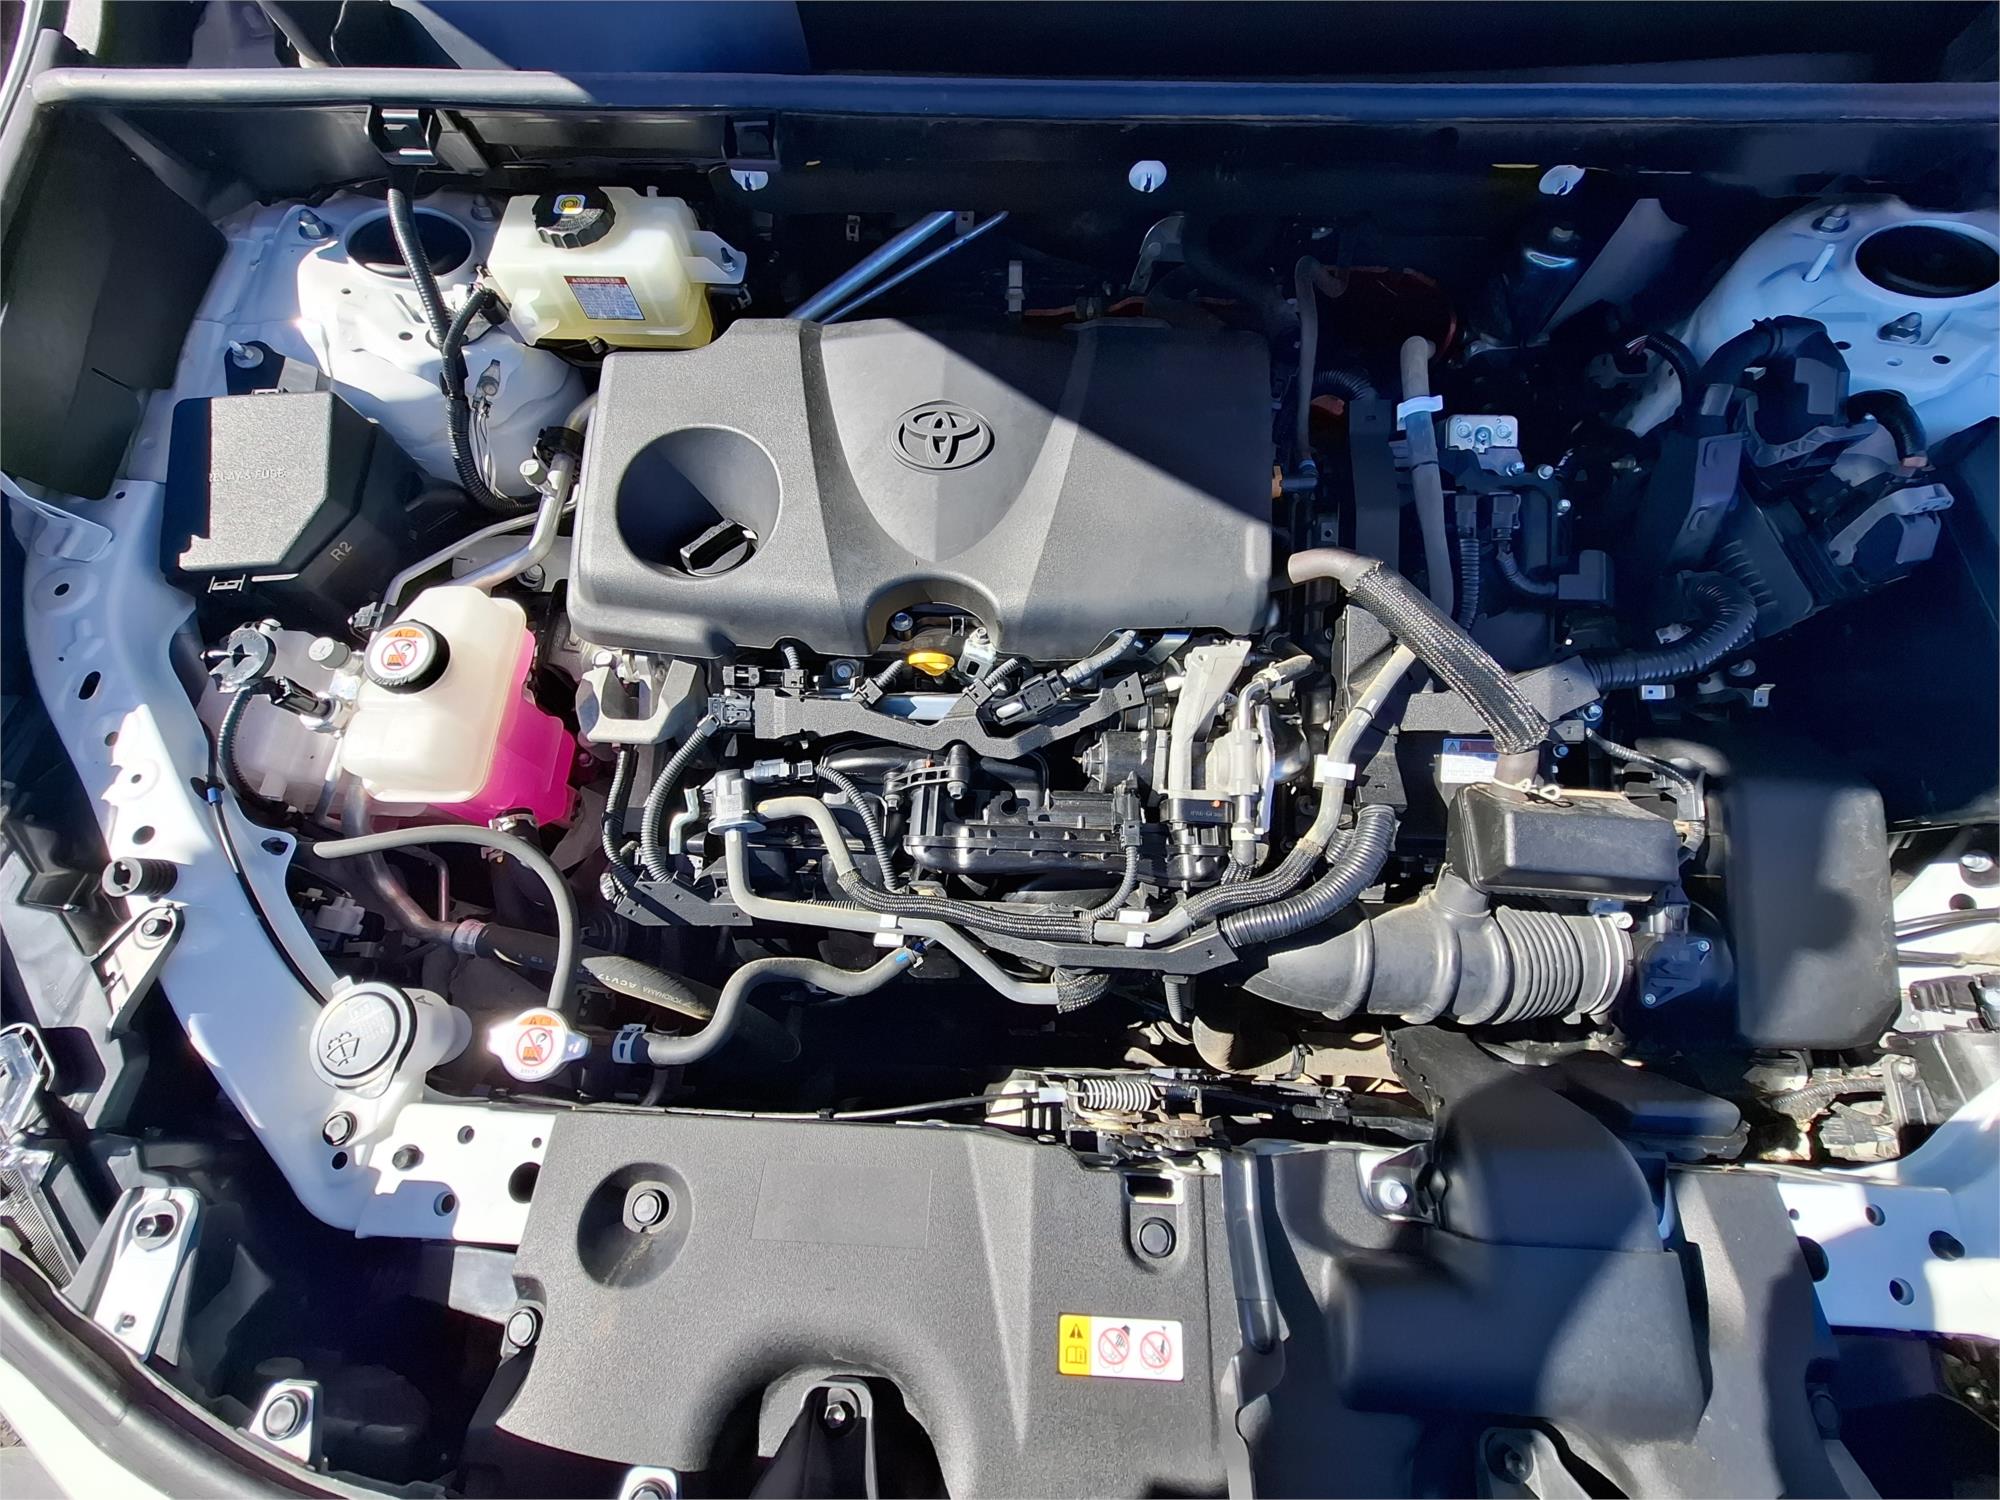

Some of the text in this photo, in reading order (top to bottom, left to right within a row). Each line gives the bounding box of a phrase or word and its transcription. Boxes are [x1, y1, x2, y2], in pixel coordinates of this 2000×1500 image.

[330, 541, 352, 561] R2
[597, 973, 682, 1003] YOKOHAMA ACV17
